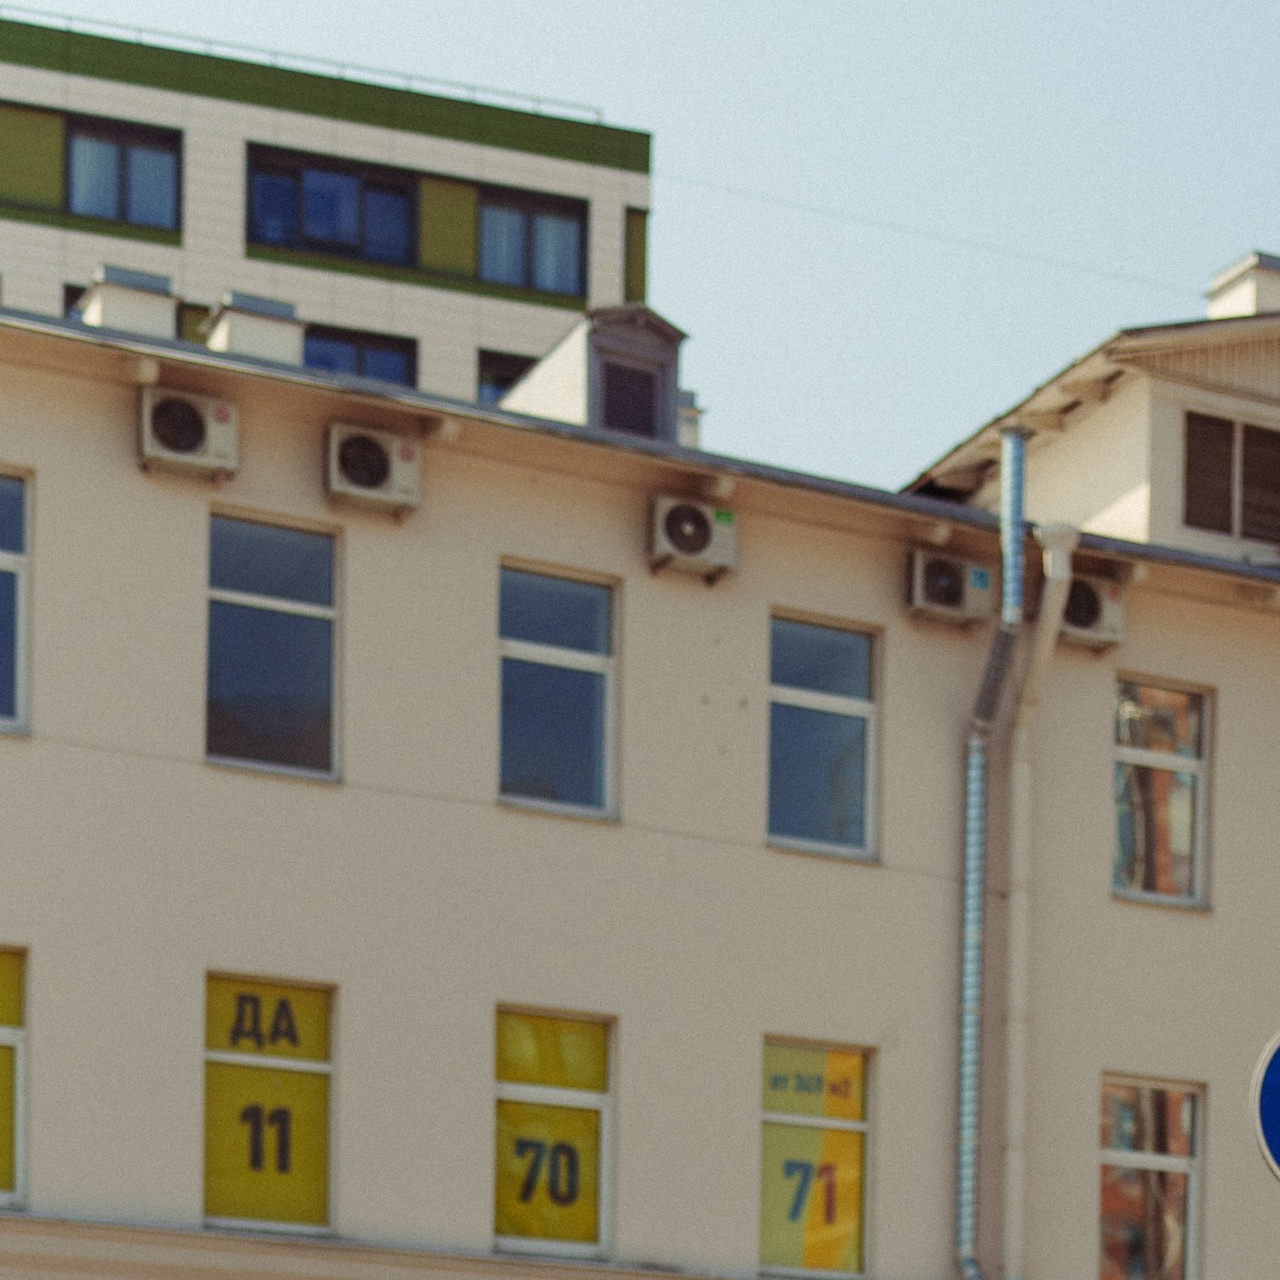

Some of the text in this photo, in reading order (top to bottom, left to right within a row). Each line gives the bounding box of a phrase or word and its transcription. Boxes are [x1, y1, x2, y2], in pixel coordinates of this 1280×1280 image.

[229, 992, 299, 1048] ДА
[240, 1104, 291, 1175] 11
[514, 1137, 578, 1207] 70
[783, 1159, 837, 1227] 71
